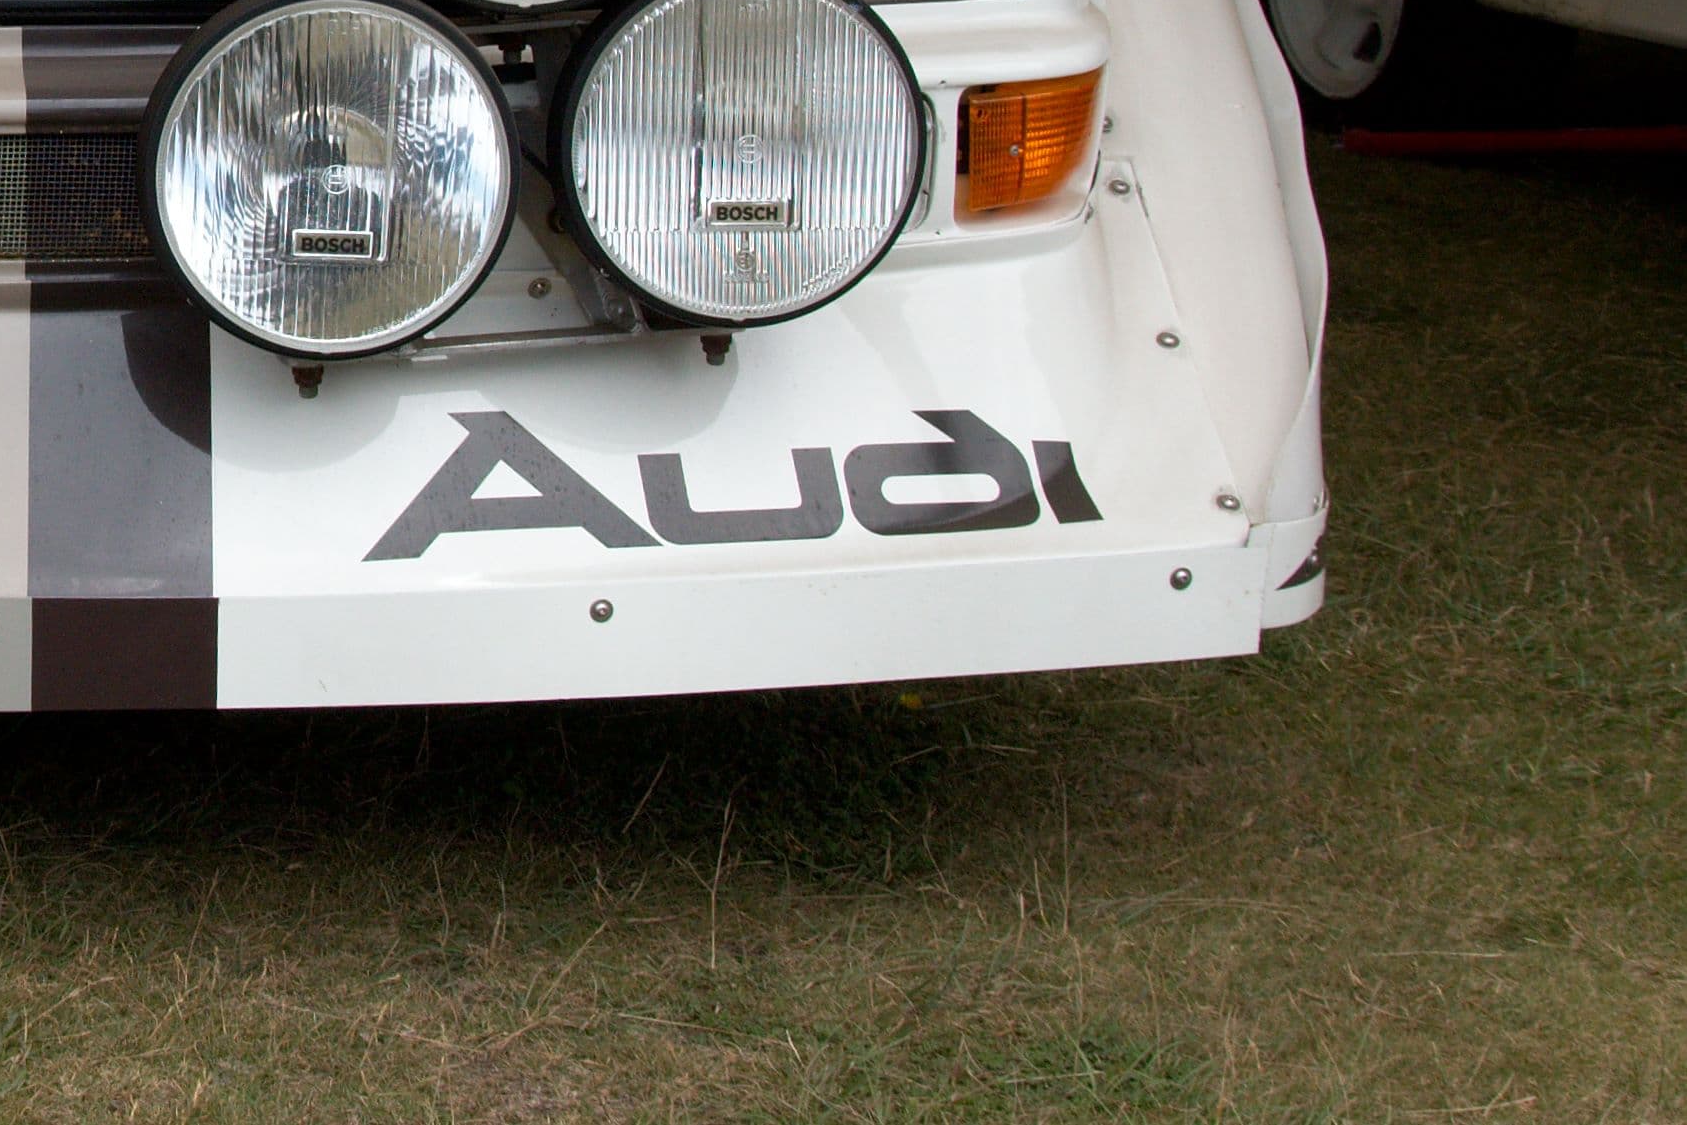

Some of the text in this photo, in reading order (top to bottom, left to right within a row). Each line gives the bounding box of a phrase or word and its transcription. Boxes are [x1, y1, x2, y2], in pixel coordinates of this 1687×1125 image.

[715, 205, 779, 221] BOSCH
[300, 236, 366, 252] BOSCH
[361, 409, 1104, 563] Audi
